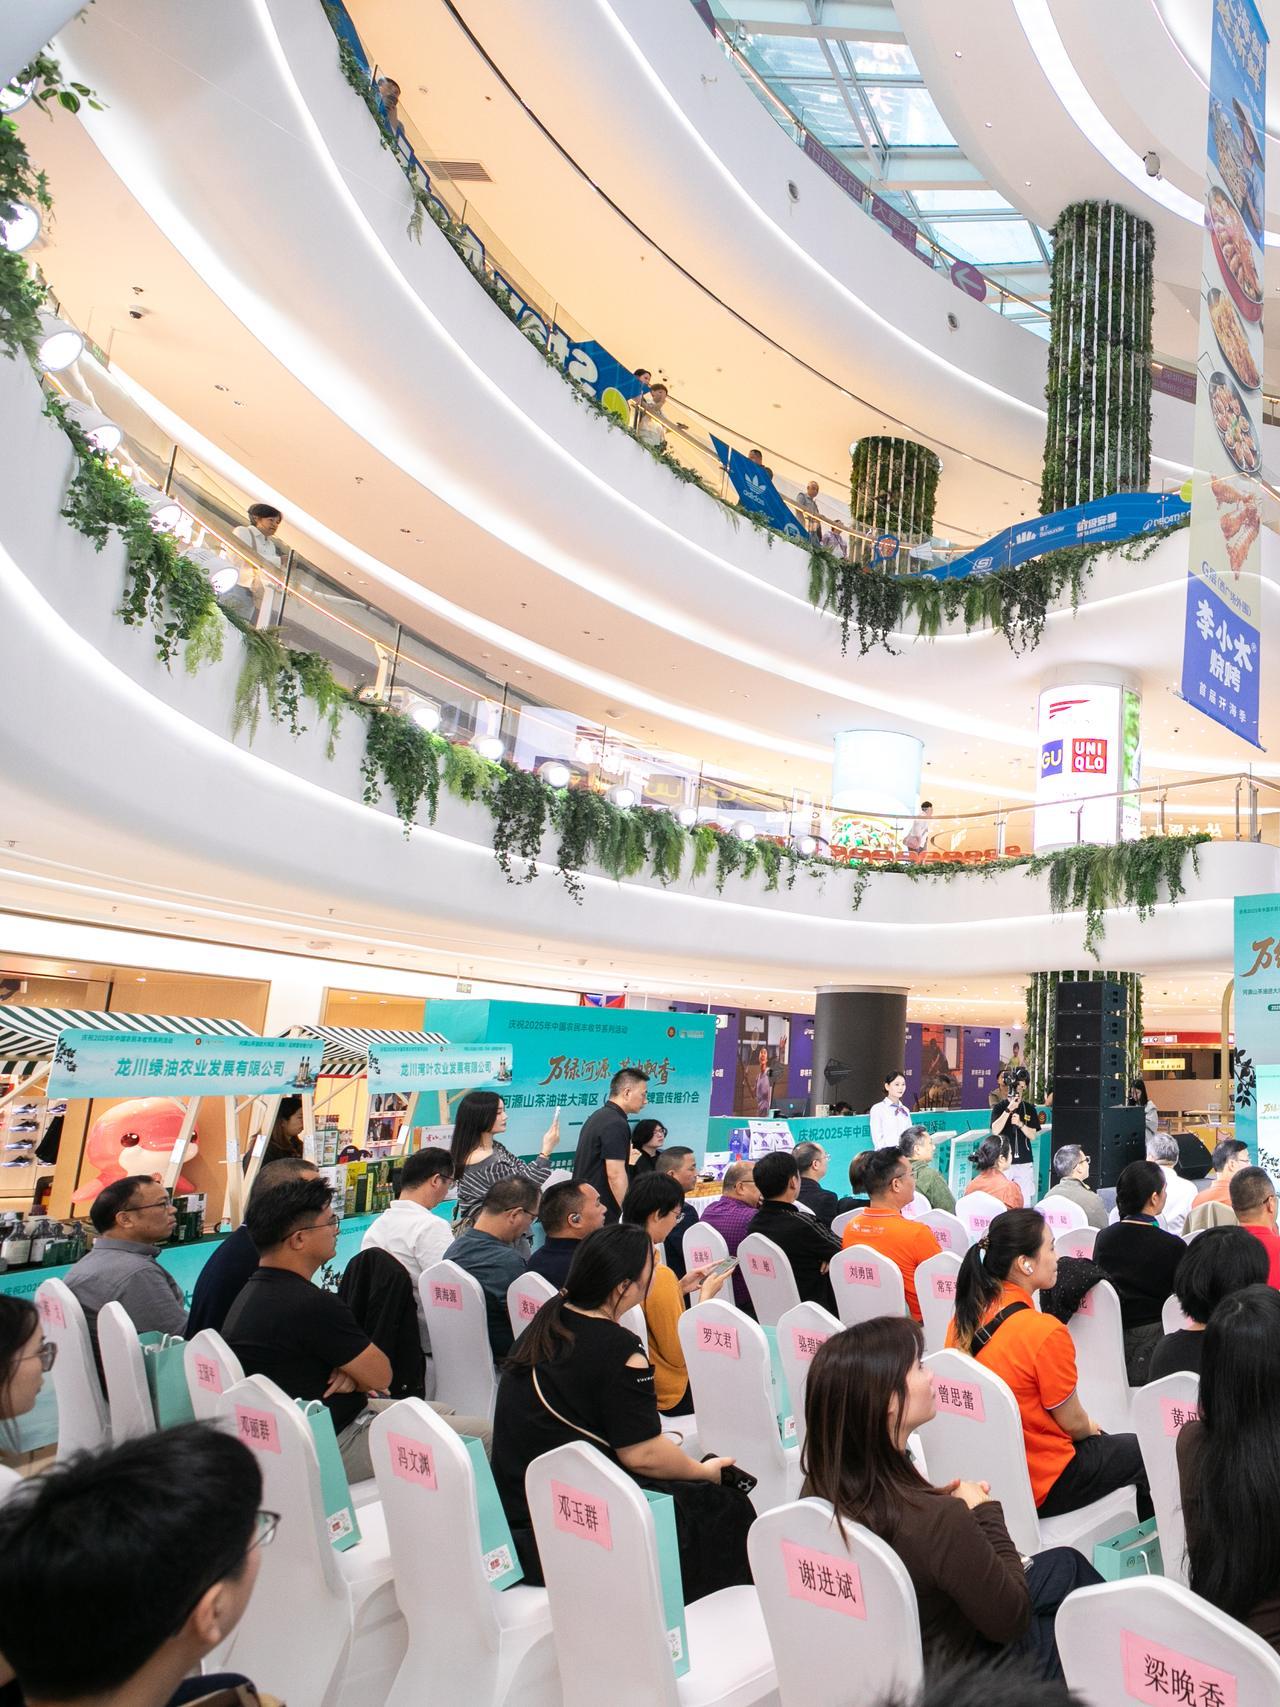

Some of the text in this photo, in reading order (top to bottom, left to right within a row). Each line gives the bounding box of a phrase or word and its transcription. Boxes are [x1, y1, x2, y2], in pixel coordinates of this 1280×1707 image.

[1196, 599, 1253, 673] 李小太
[1209, 648, 1241, 693] 烧烤
[1042, 750, 1063, 769] GU
[509, 1019, 628, 1034] 庆祝2025年中国农民丰收节系列活动
[115, 1057, 286, 1079] 龙川绿油农业发展有限公司
[538, 1055, 612, 1086] 万绿河源
[849, 1265, 874, 1281] 刘勇国
[703, 1327, 732, 1349] 罗文君
[938, 1384, 974, 1411] 曾思蕾
[558, 1494, 599, 1532] 邓玉群
[798, 1559, 857, 1604] 谢进斌
[1144, 1653, 1226, 1707] 梁晚香
